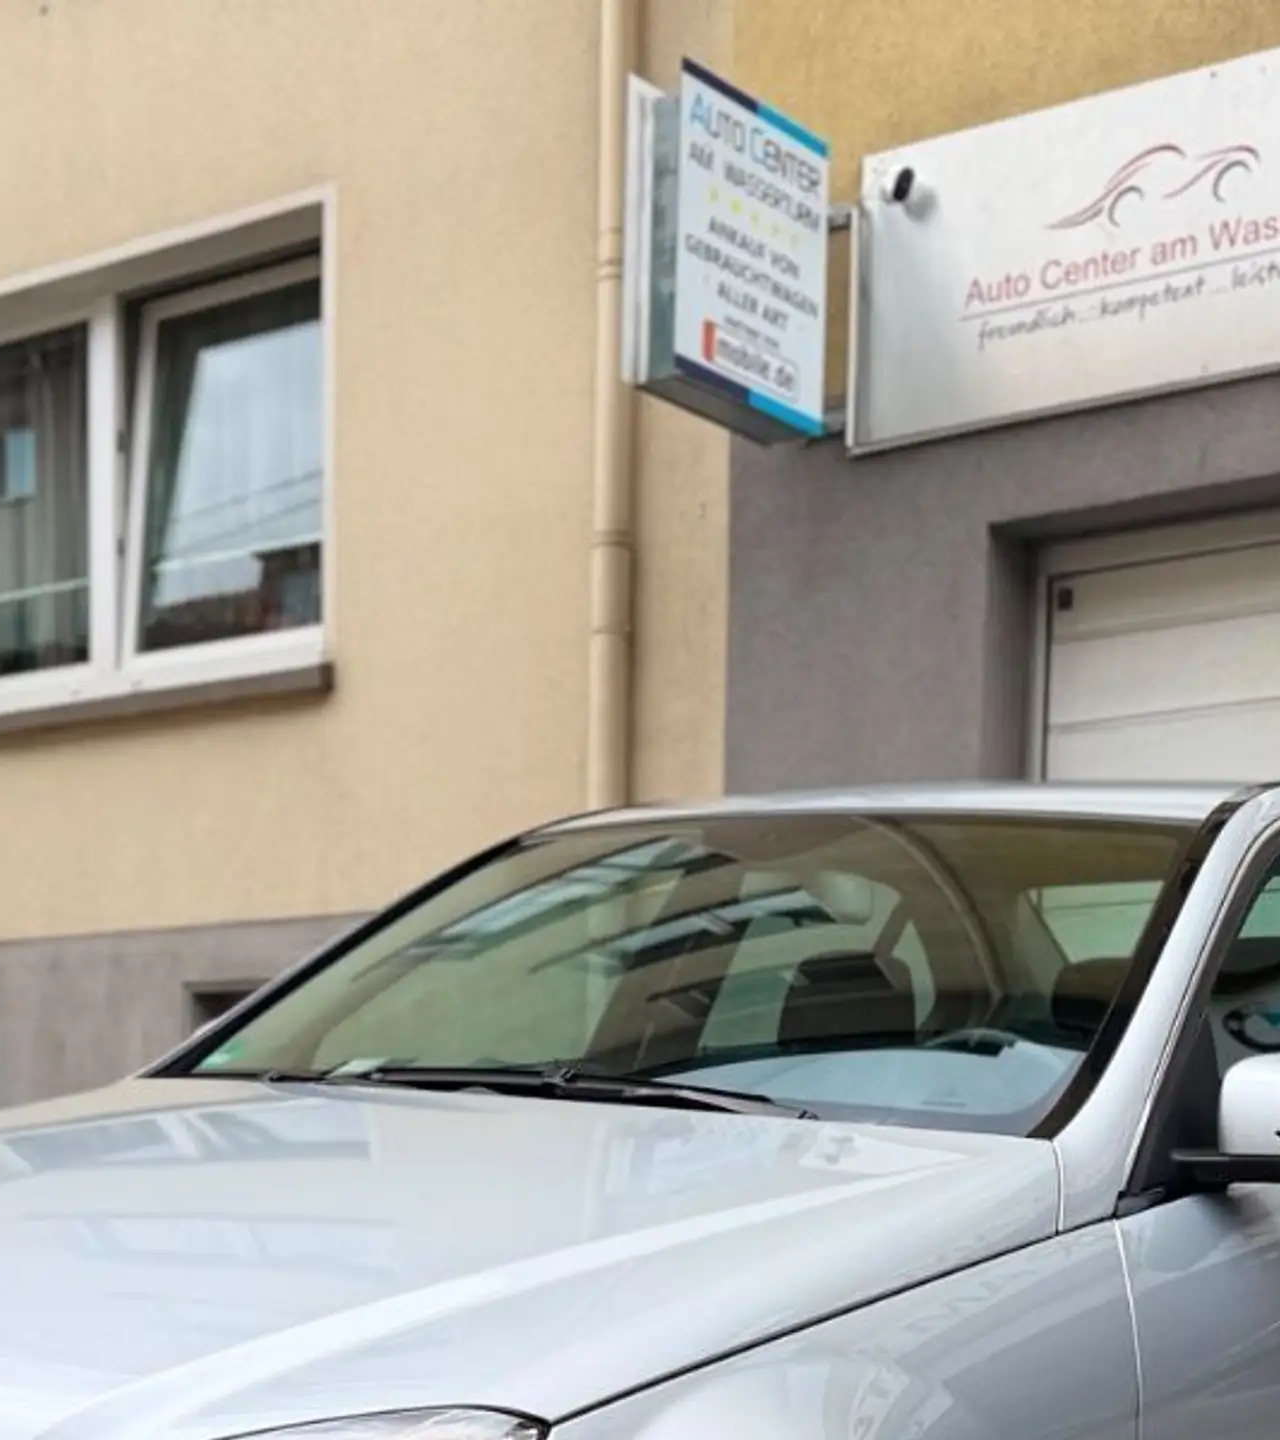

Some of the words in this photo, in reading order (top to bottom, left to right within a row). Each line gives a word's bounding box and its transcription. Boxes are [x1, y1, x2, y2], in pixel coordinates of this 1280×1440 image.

[689, 92, 746, 154] AUTO
[750, 127, 821, 194] CENTER
[964, 276, 1032, 311] Auto
[1039, 247, 1142, 291] Center
[1149, 234, 1198, 266] am
